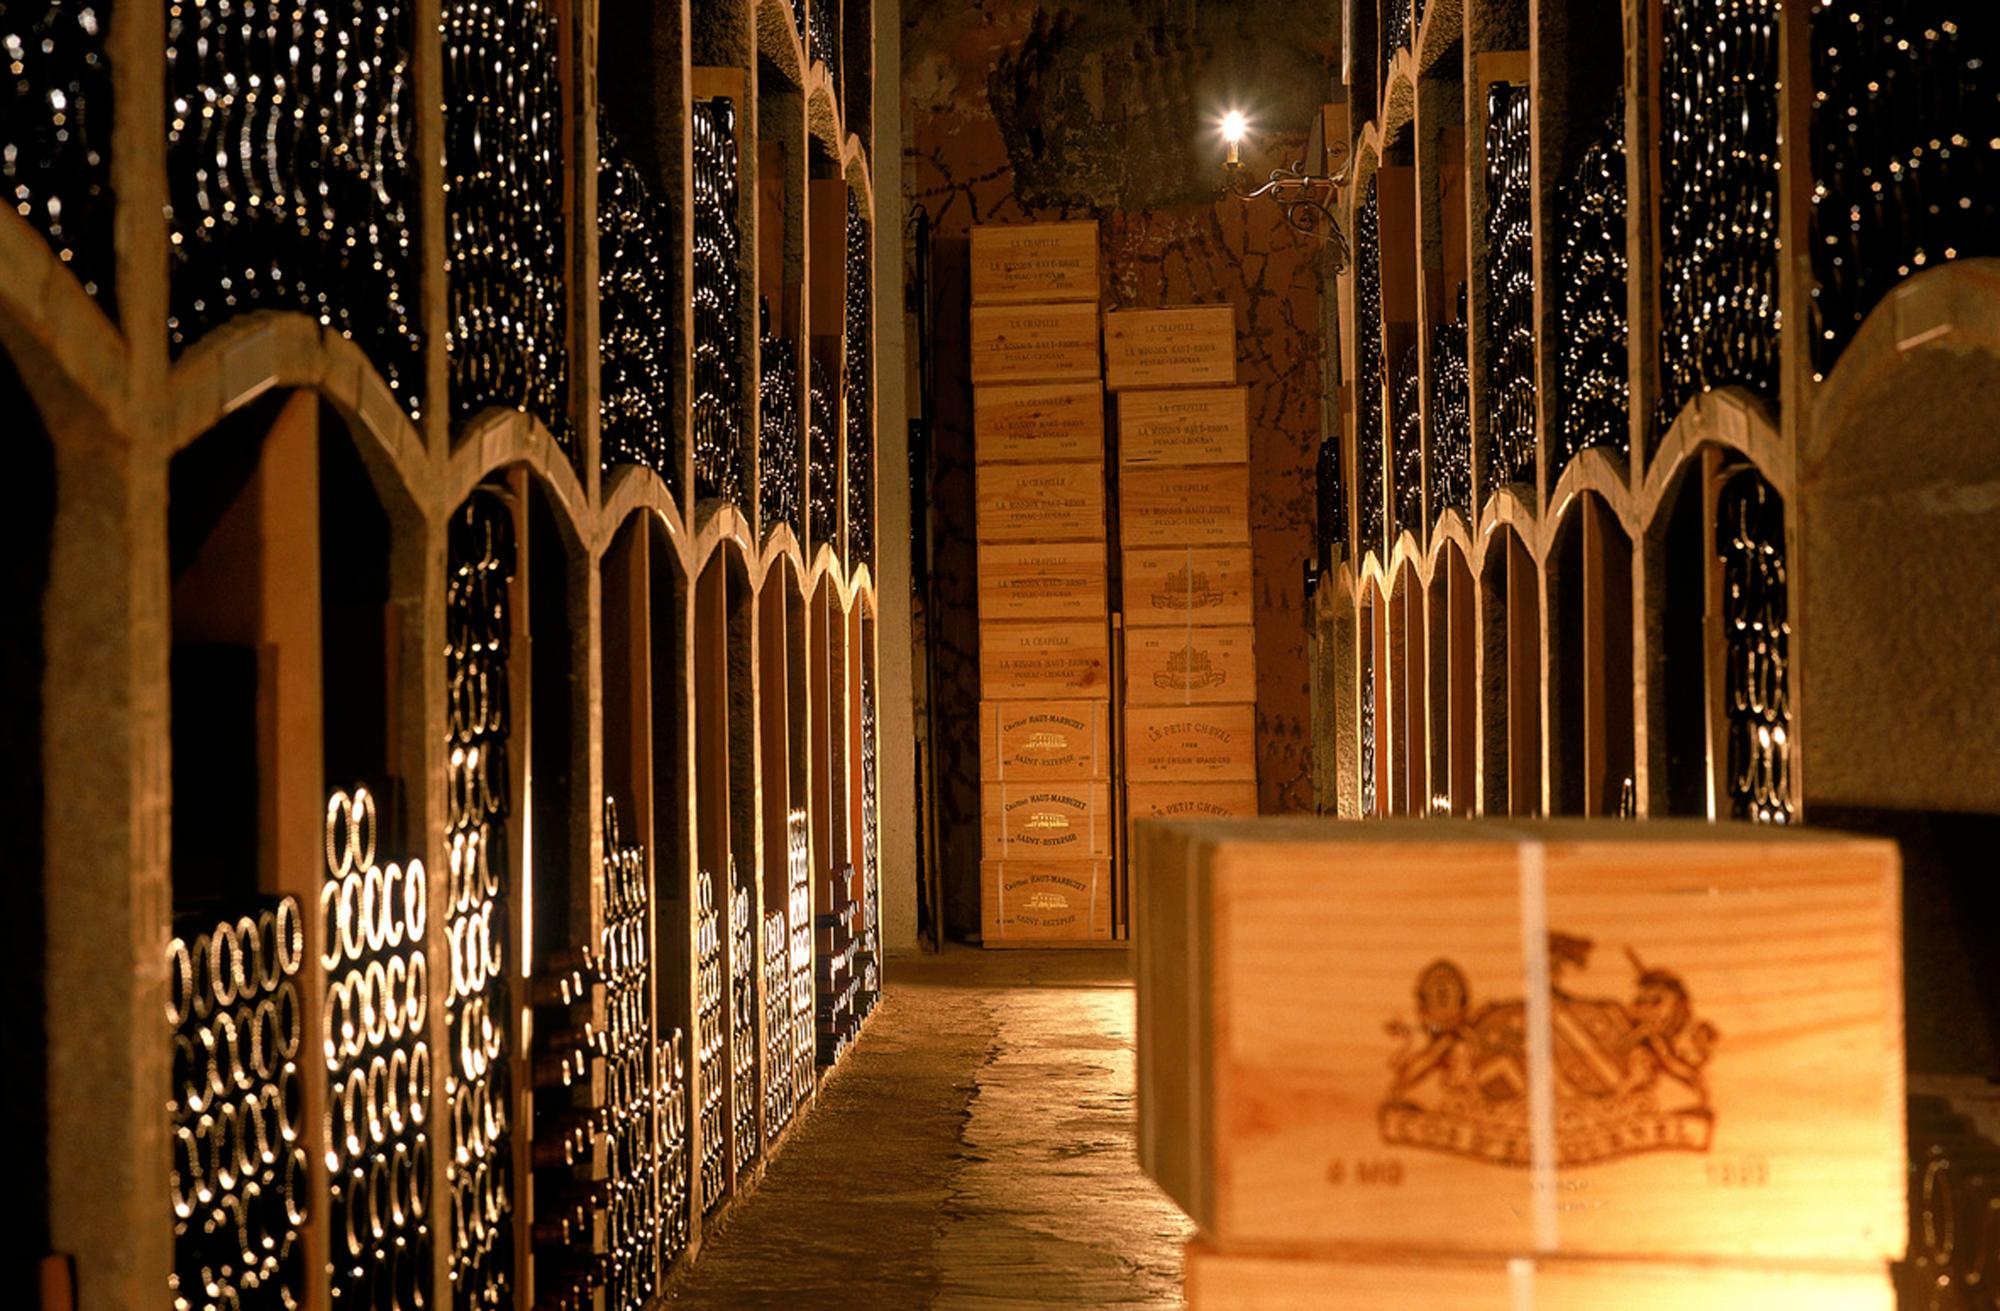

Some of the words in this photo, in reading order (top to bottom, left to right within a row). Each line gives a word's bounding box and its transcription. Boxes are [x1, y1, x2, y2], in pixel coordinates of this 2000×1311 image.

[1029, 714, 1086, 731] HAUT-MARBUZET
[1148, 729, 1163, 743] LE
[1163, 722, 1193, 736] PETIT
[1194, 722, 1232, 744] CHEVAL
[1030, 794, 1087, 811] HAUT-MARBUZET
[1166, 801, 1194, 815] PETIT
[1030, 874, 1087, 892] HAUT-MARBUZET
